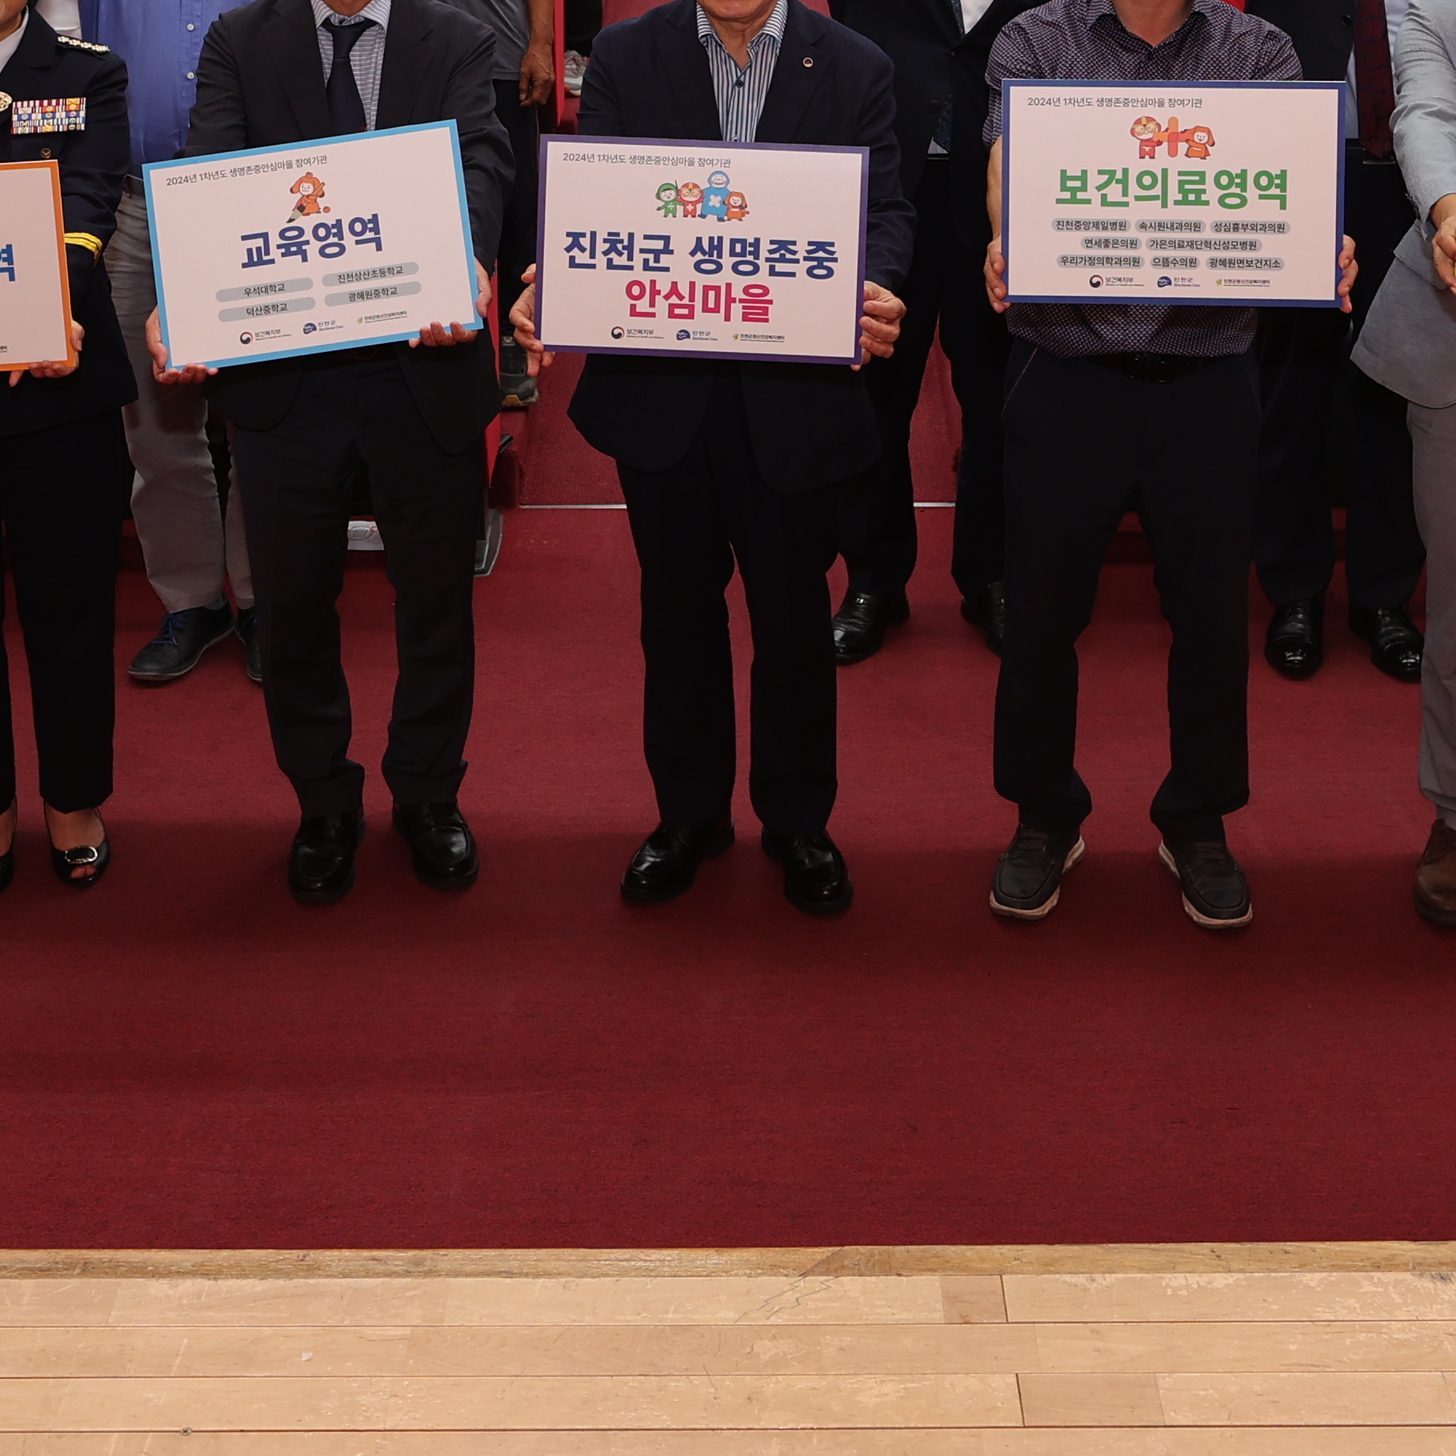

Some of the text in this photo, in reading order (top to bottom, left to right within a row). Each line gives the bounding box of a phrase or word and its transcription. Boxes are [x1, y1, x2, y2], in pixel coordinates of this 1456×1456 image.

[1027, 96, 1203, 109] 2024년 1차년도 생명존중안심마을 참여기관
[166, 154, 328, 187] 2024년 1차년도 생명존중안심마을 참여기관
[562, 152, 732, 169] 2024년 1차년도 생명존중안심마을 참여기관
[1055, 167, 1288, 211] 보건의료영역
[240, 213, 384, 269] 교육영역
[1056, 220, 1285, 233] 진천중앙제일병원 속시원내과의원 성심흉부외과의원
[563, 230, 839, 280] 진천군 생명존중
[1084, 238, 1257, 250] 연세좋은의원 가은의료재단혁신성모병원
[1060, 256, 1140, 267] 우리가정의학과의원
[1209, 258, 1281, 269] 광혜원면보건지소
[244, 266, 404, 298] 우석대학교 진천상산초등학교
[246, 286, 398, 318] 덕산중학교 광혜원중학교
[624, 279, 774, 323] 안심마을
